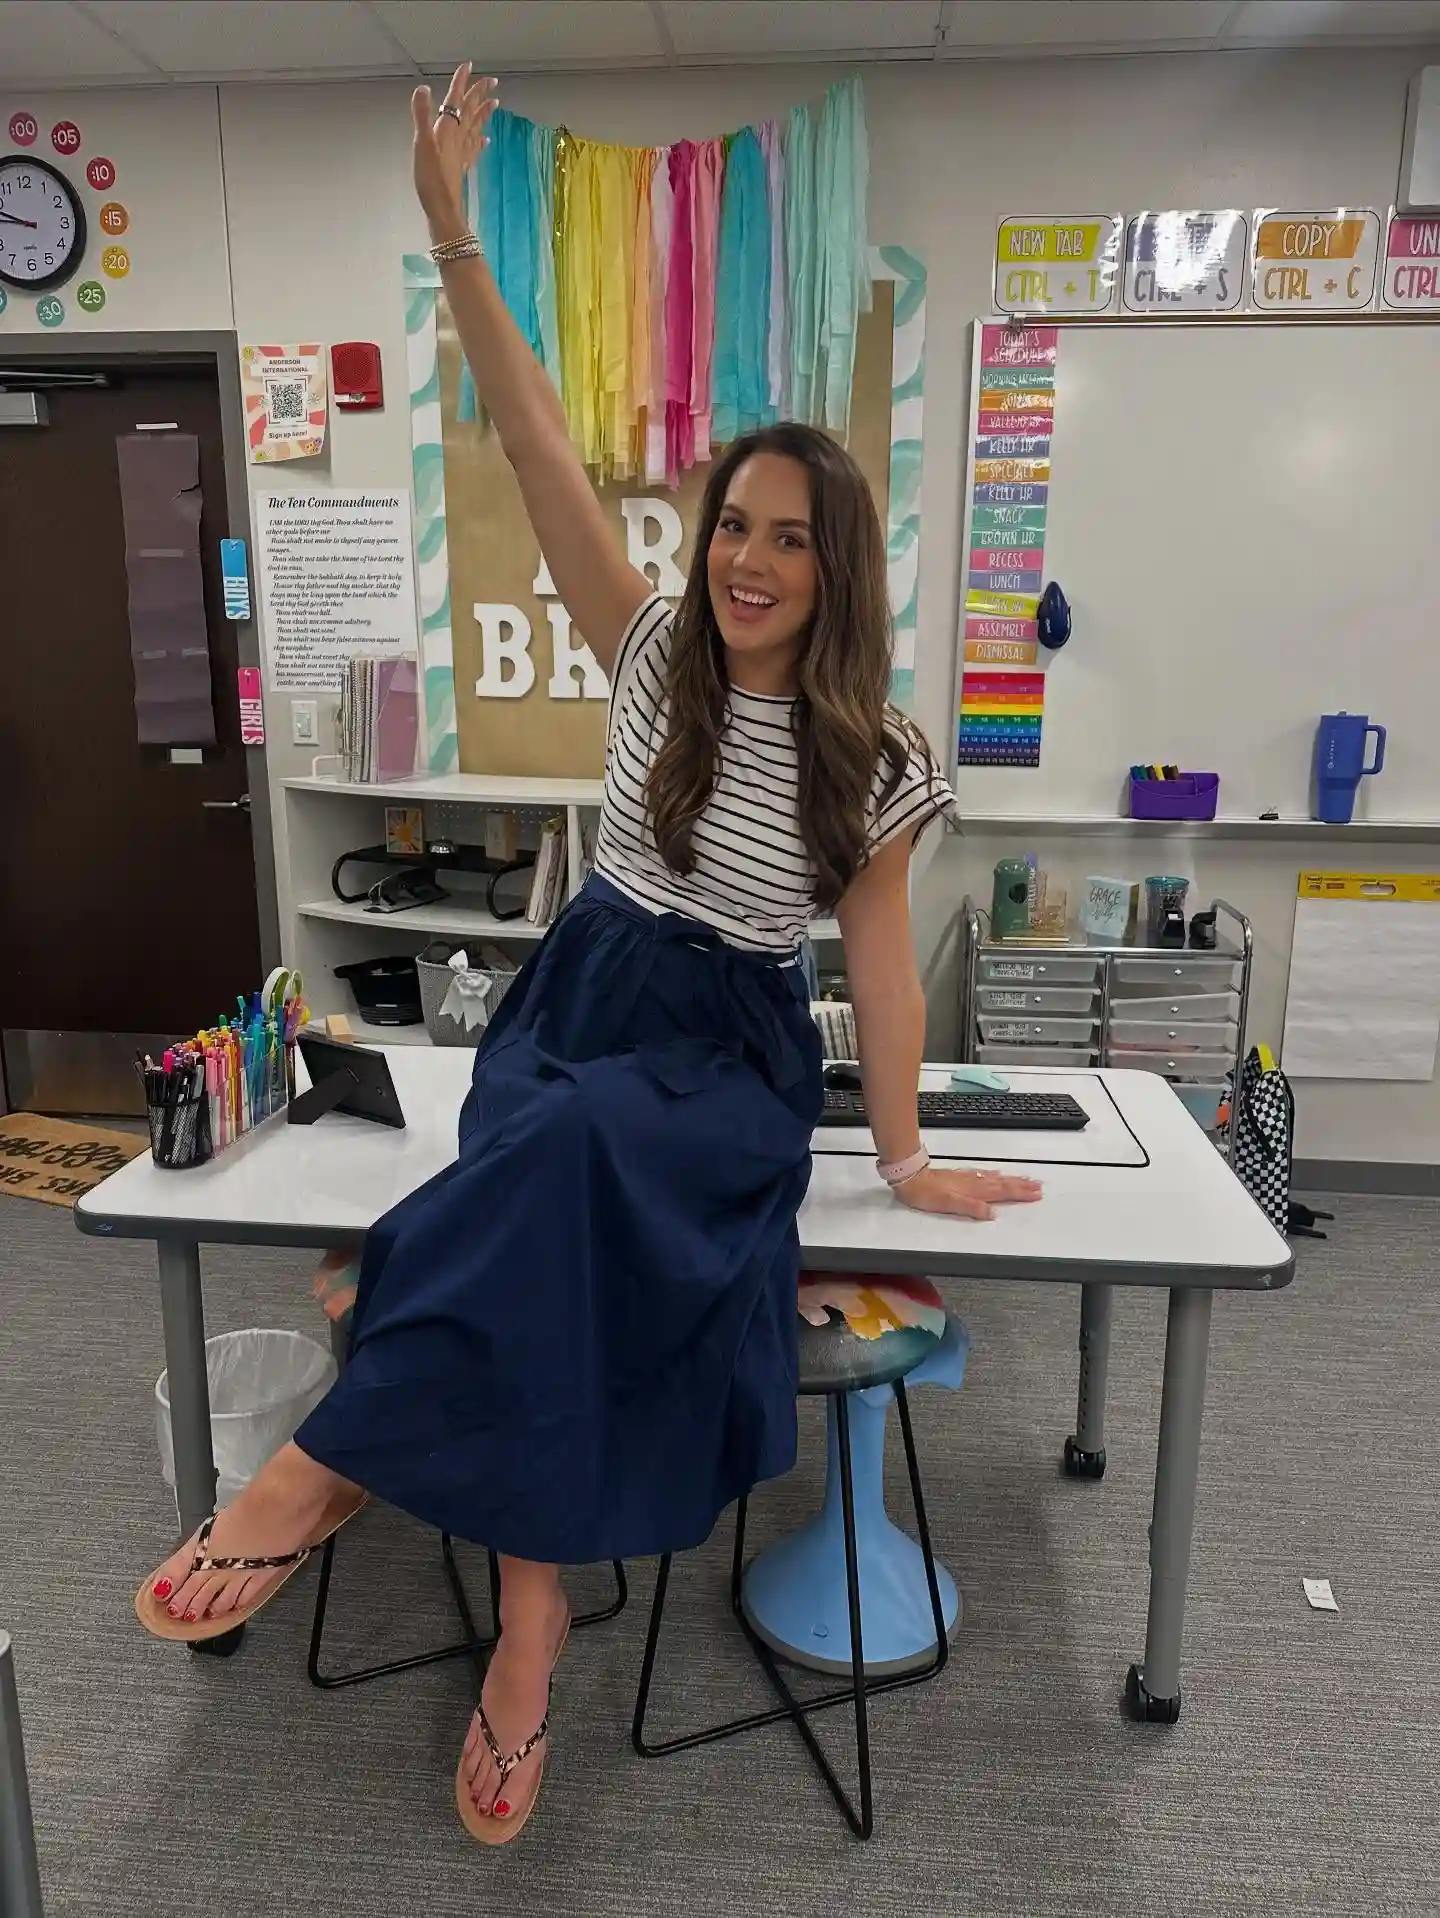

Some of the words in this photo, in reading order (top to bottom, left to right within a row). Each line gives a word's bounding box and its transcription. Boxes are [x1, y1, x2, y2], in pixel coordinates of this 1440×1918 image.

[53, 130, 77, 145] :05
[1, 182, 12, 195] 11
[17, 175, 32, 189] 12
[41, 181, 47, 194] 1
[53, 196, 63, 209] 2
[60, 216, 70, 229] 3
[105, 211, 121, 226] :15
[57, 237, 66, 250] 4
[1008, 228, 1046, 255] NEW
[1055, 228, 1085, 256] TAB
[1281, 222, 1338, 257] COPY
[1409, 223, 1440, 255] UN
[9, 254, 17, 266] 7
[27, 259, 37, 271] 6
[44, 253, 54, 265] 5
[104, 254, 127, 270] :20
[1005, 270, 1052, 303] CTRL
[1063, 280, 1077, 295] +
[1216, 268, 1228, 302] S
[1264, 267, 1312, 300] CTRL
[1325, 280, 1337, 293] +
[1347, 266, 1360, 299] C
[79, 288, 101, 303] :25
[39, 301, 61, 320] :30
[262, 366, 308, 374] INTERNATIONAL
[268, 497, 287, 508] The
[287, 497, 306, 508] Ten
[307, 496, 399, 508] Commandments
[283, 518, 294, 528] the
[335, 518, 352, 528] Thou
[993, 507, 1026, 524] SNACK
[265, 528, 283, 537] other
[981, 531, 1017, 545] BROWN
[1021, 531, 1036, 545] HR
[270, 537, 286, 546] Thou
[303, 537, 314, 546] not
[333, 537, 341, 546] to
[272, 555, 288, 563] Thou
[304, 555, 316, 563] not
[990, 552, 1024, 568] RECESS
[990, 574, 1021, 589] LUNCH
[223, 577, 250, 618] BOYS
[341, 591, 352, 600] the
[978, 623, 1026, 639] ASSEMBLY
[976, 644, 1024, 660] DISMISSAL
[239, 699, 265, 744] GIRLS
[1090, 887, 1121, 905] GRACE
